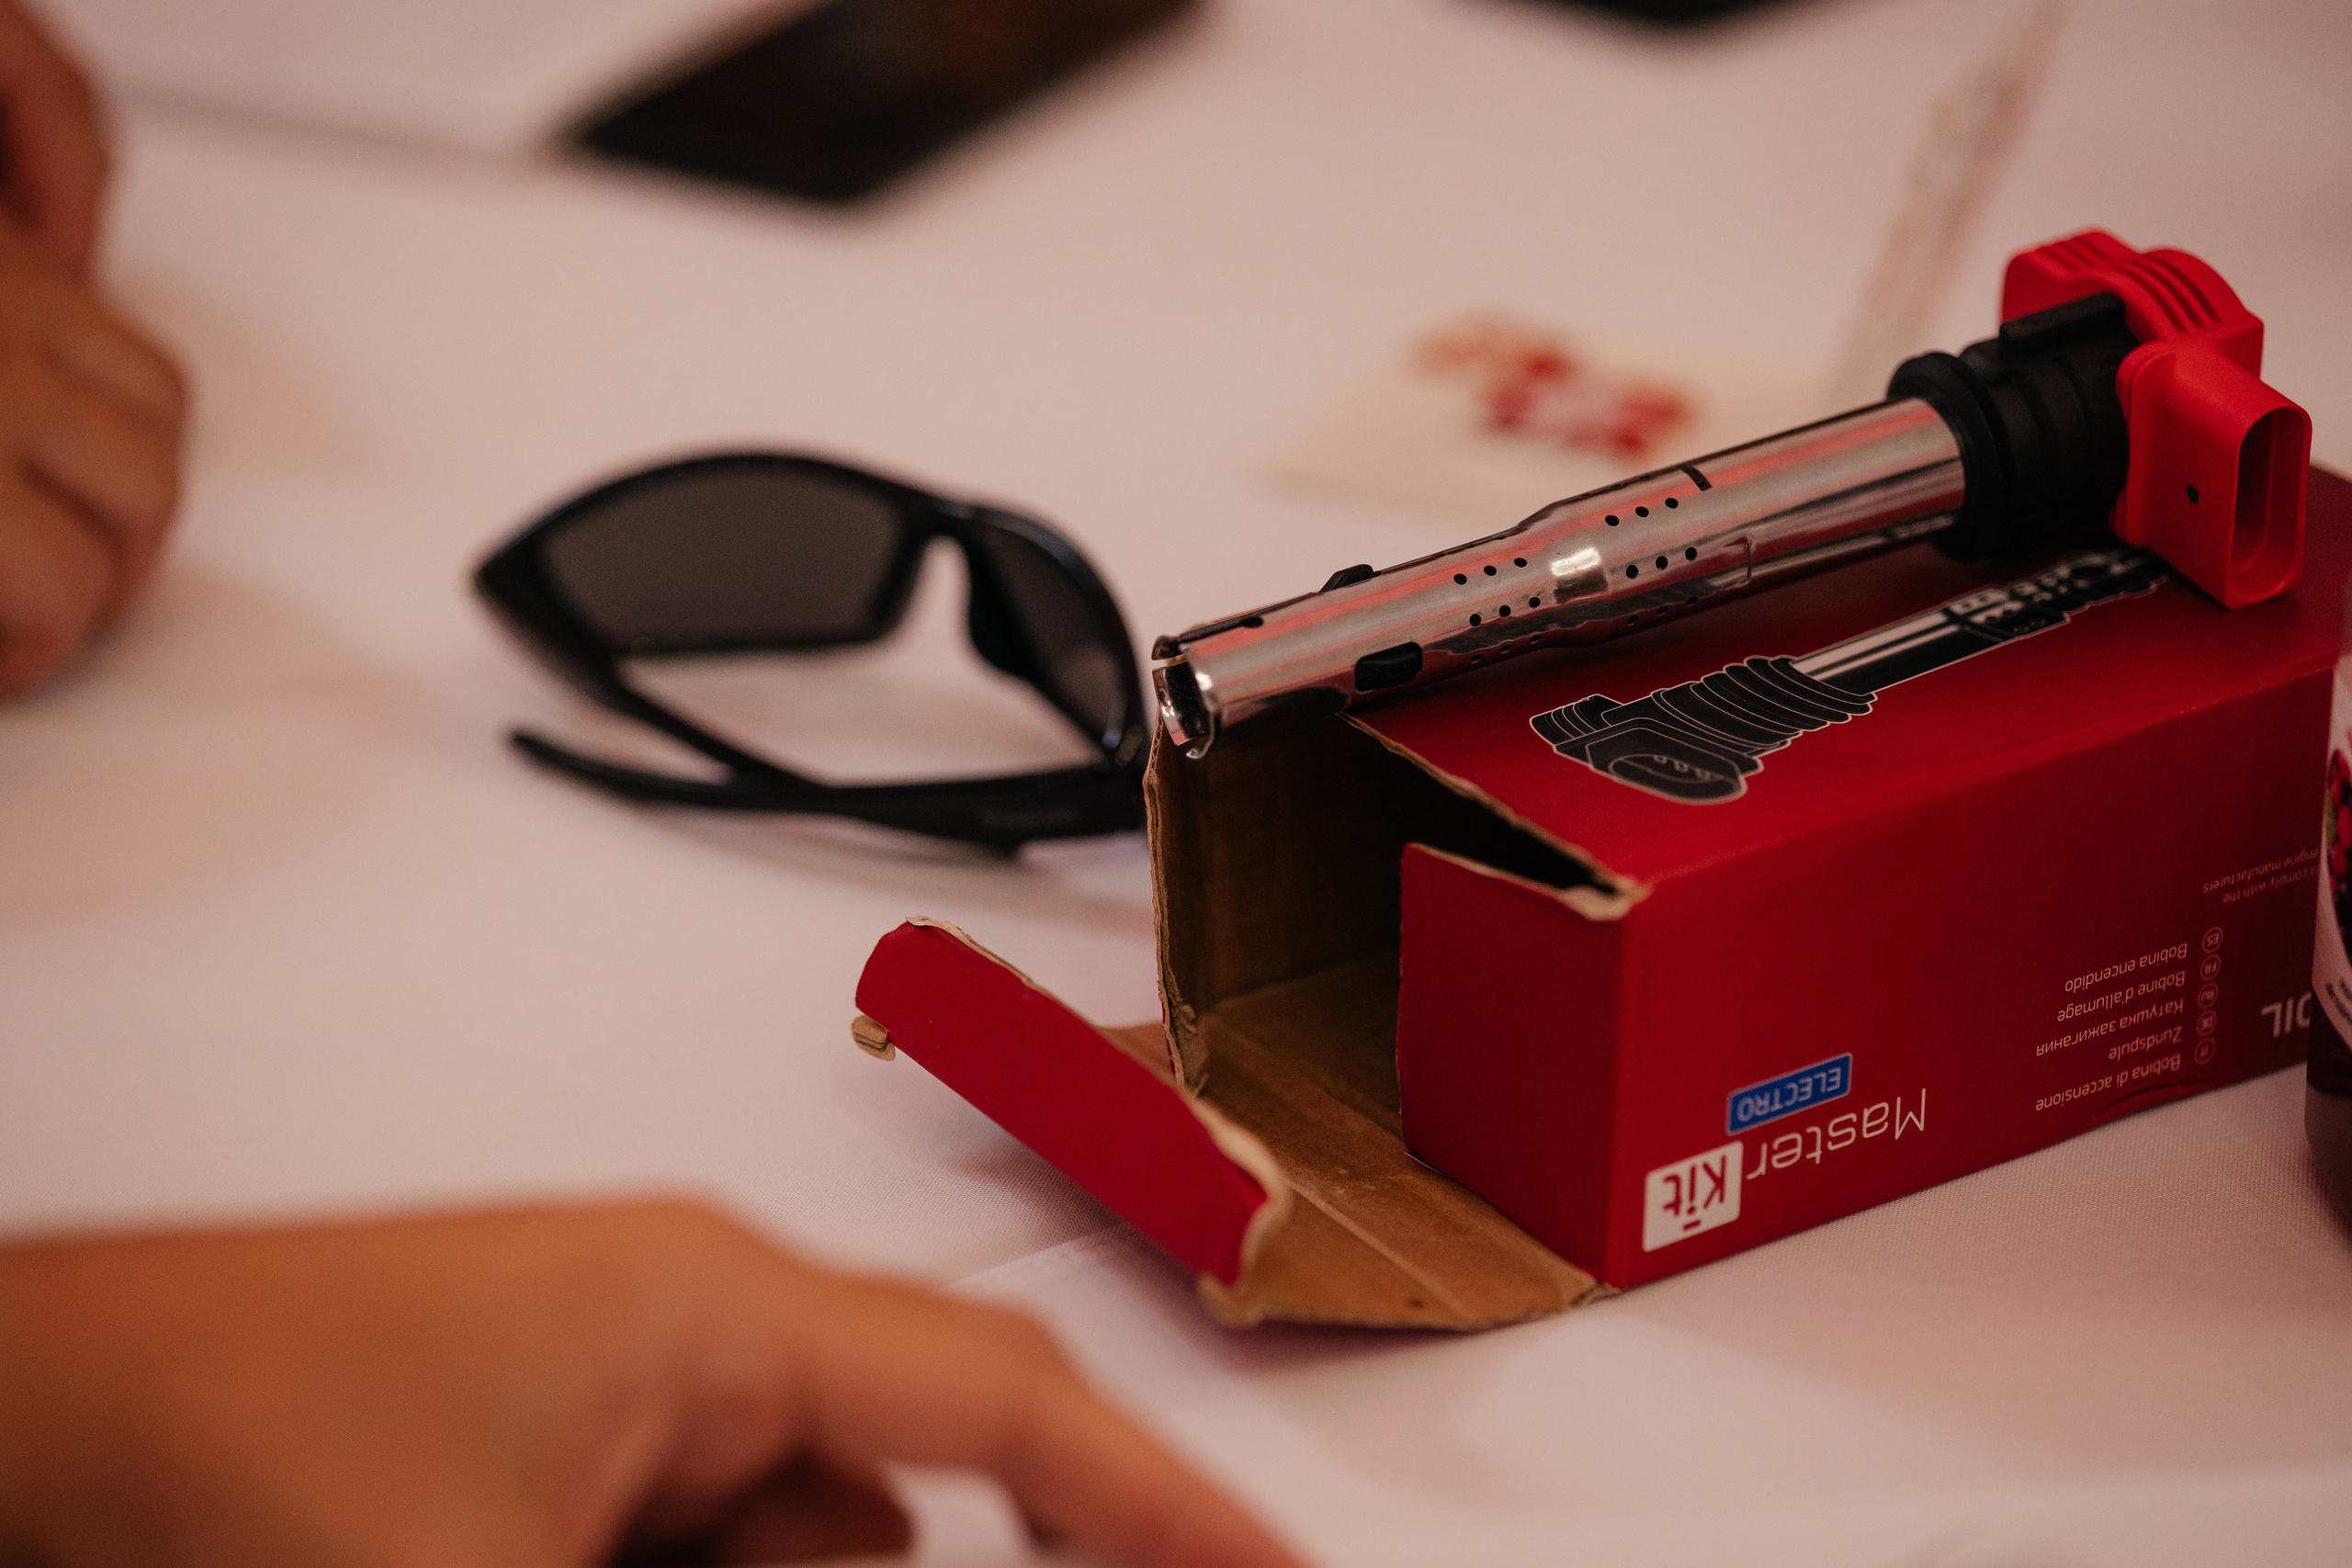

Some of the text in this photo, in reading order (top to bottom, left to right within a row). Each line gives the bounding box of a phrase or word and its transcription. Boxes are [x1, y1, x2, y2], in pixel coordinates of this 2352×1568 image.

[2202, 848, 2319, 894] engine manufacturers
[2269, 868, 2307, 889] comply
[2222, 890, 2241, 904] the
[2243, 881, 2267, 898] with
[2139, 942, 2188, 969] Bobina
[2064, 959, 2136, 993] encendido
[2137, 970, 2186, 997] Bobine
[2056, 987, 2133, 1023] d'allumage
[2119, 998, 2184, 1028] Катушка
[2036, 1021, 2117, 1058] зажигания
[2109, 1025, 2182, 1061] Zündspule
[2116, 1069, 2130, 1088] di
[2132, 1053, 2181, 1080] Bobina
[1736, 1066, 1841, 1122] ELECTRO
[2035, 1076, 2113, 1111] accensione
[1746, 1088, 1926, 1181] Master
